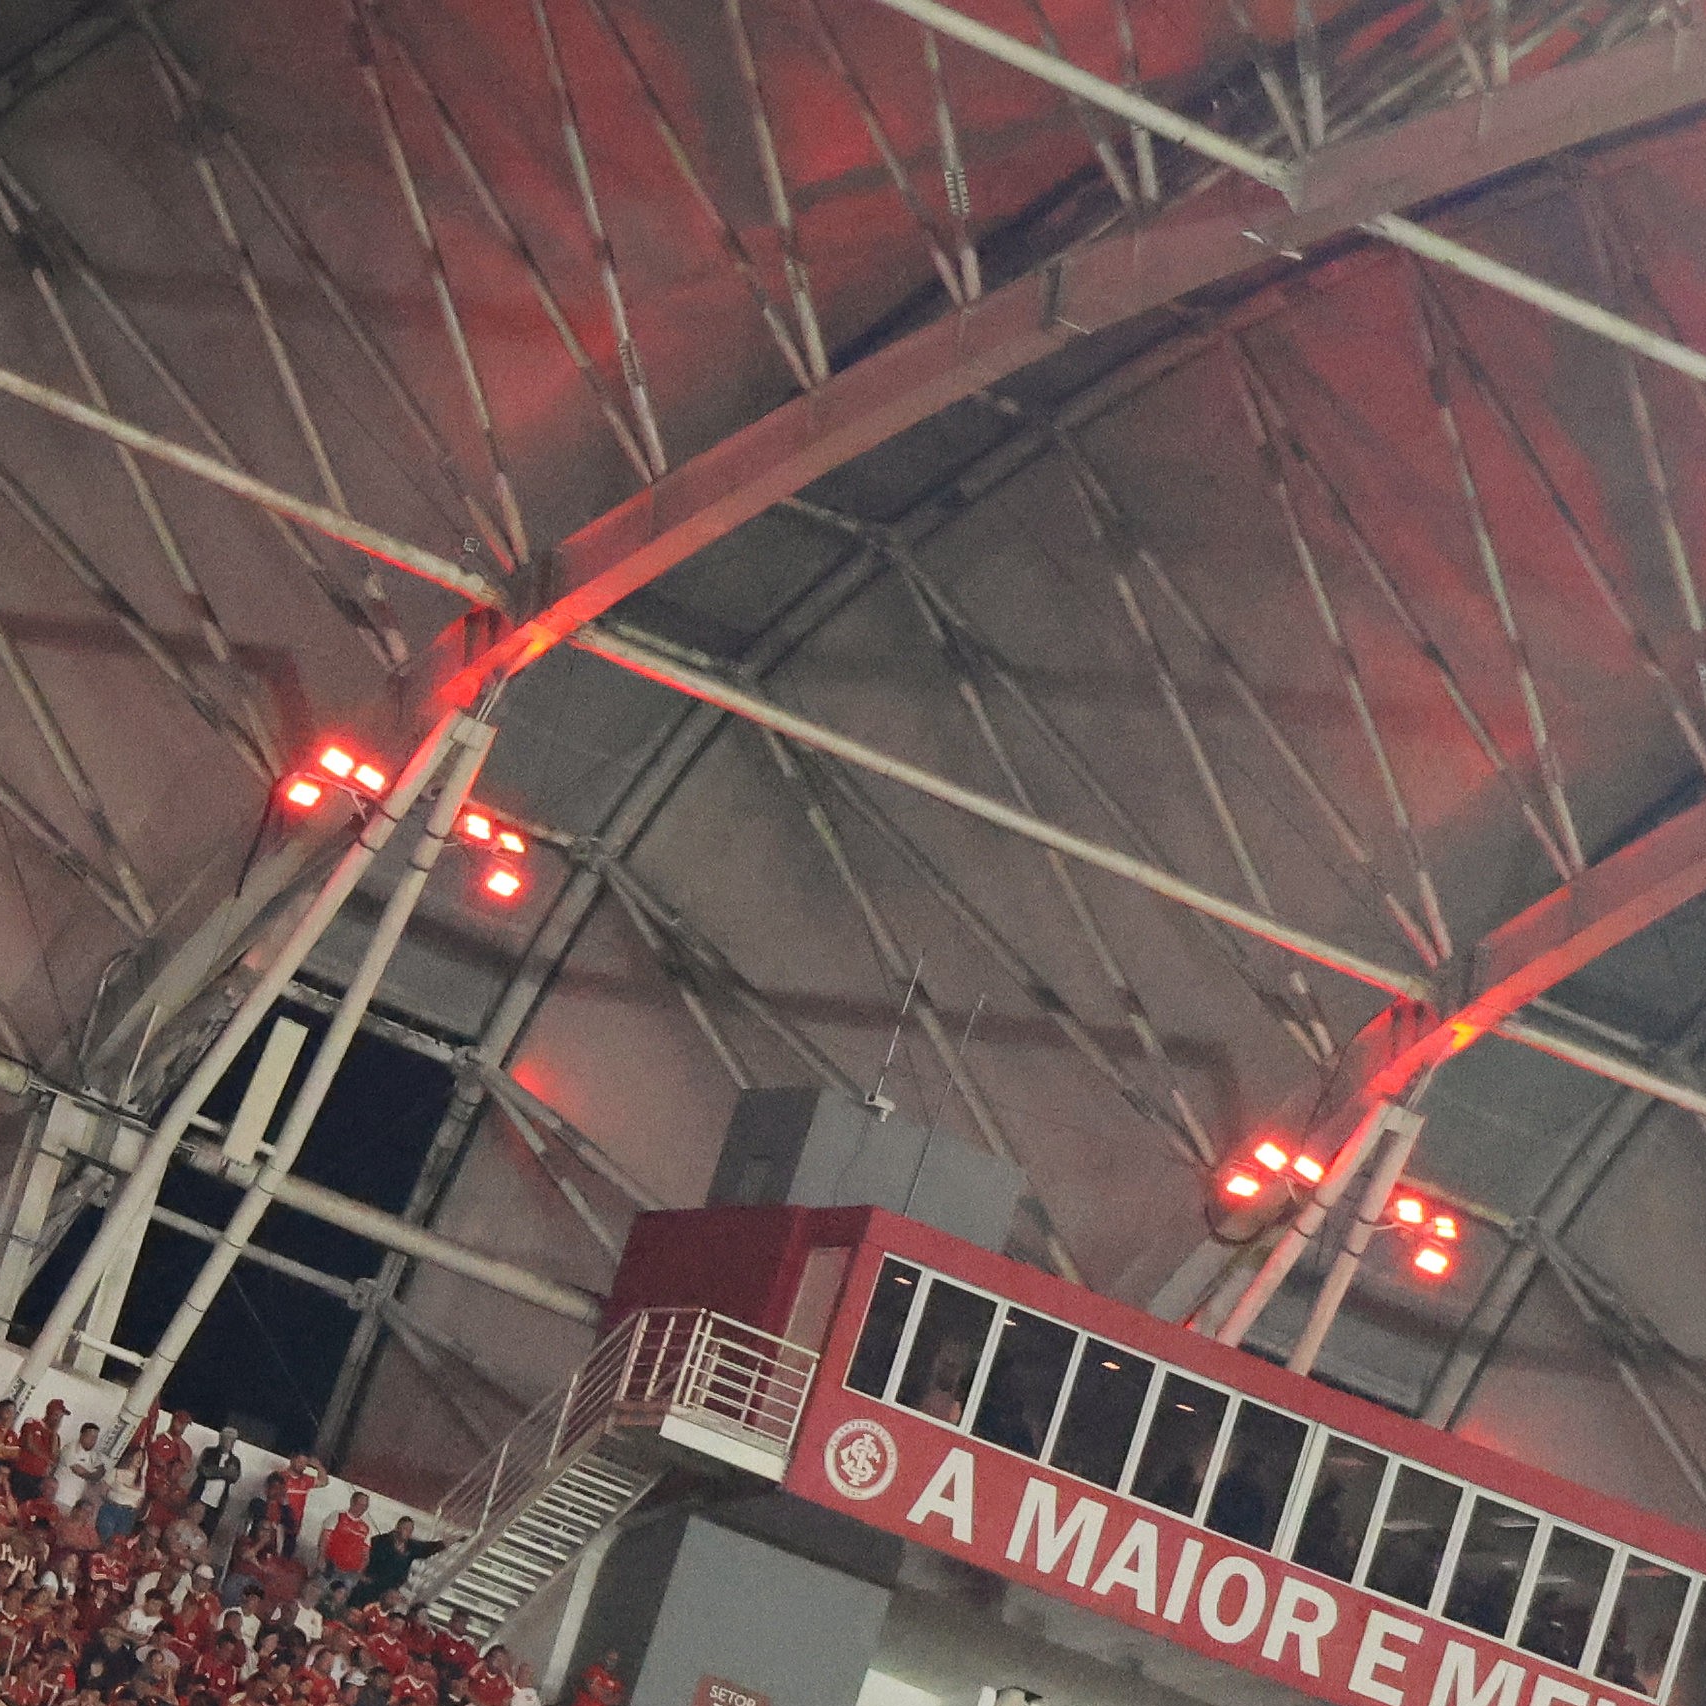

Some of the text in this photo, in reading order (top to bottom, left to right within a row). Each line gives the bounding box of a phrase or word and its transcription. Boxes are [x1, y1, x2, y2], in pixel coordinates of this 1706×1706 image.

[907, 1448, 974, 1543] A
[1006, 1478, 1337, 1676] MAIOR
[1349, 1610, 1423, 1706] E
